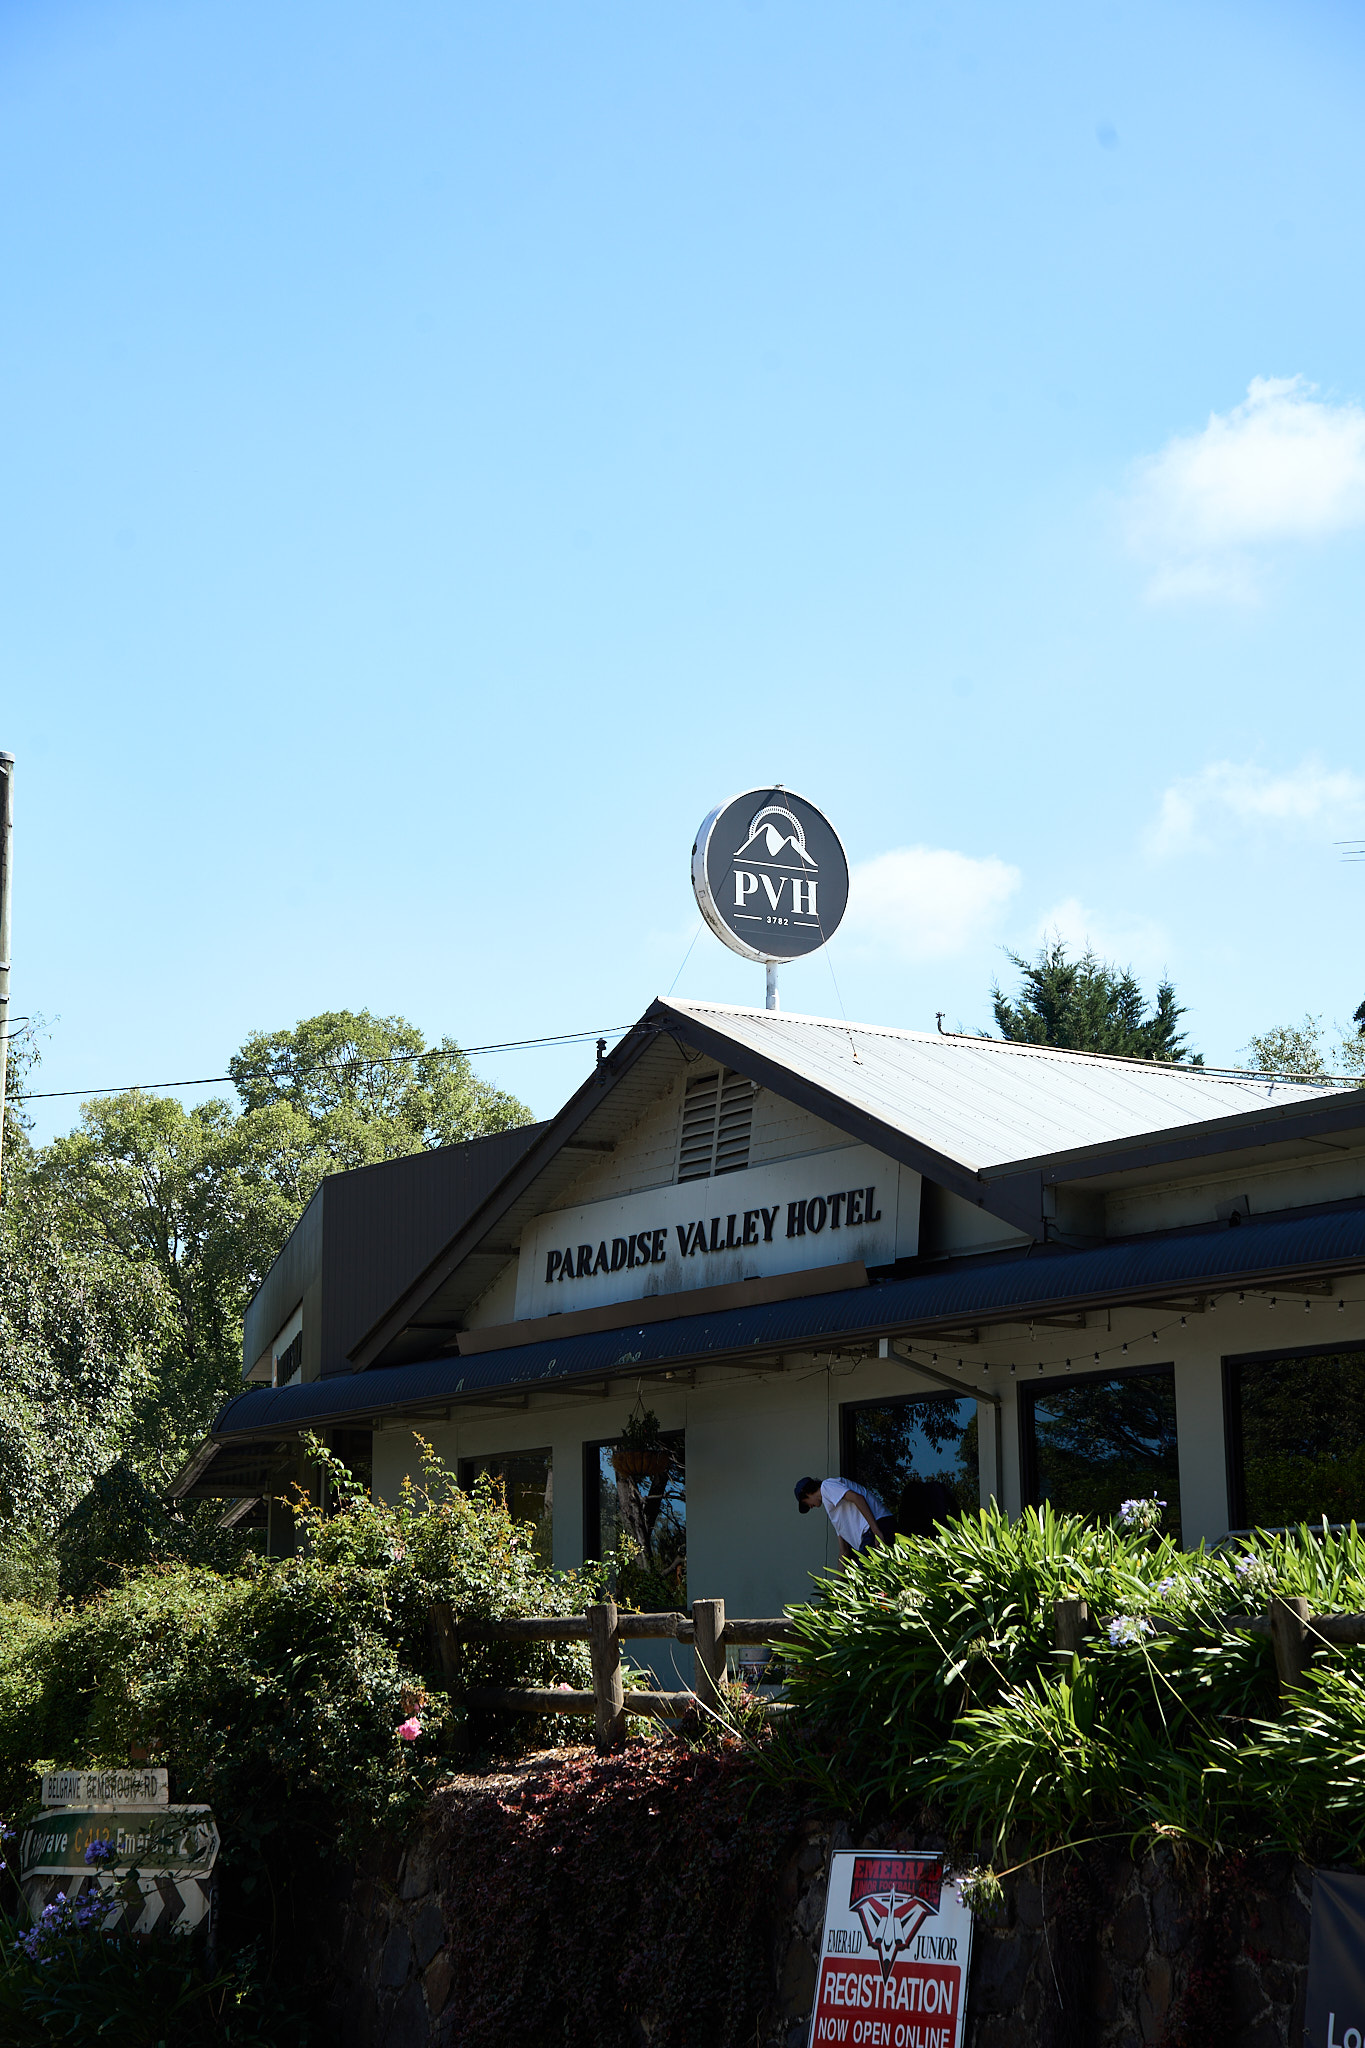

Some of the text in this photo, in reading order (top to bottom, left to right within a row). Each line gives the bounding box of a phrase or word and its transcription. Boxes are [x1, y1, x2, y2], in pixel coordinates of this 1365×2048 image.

[733, 869, 819, 916] PVH
[766, 915, 789, 927] 3782
[545, 1186, 882, 1283] PARADISE VALLEY HOTEL
[48, 1777, 80, 1799] BELGRAVE
[144, 1775, 158, 1798] RD
[827, 1929, 958, 1961] EMERALD JUNIOR
[823, 1971, 954, 2015] REGISTRATION
[817, 2016, 951, 2048] NOW OPEN ONLINE
[1327, 2011, 1365, 2048] Lo
